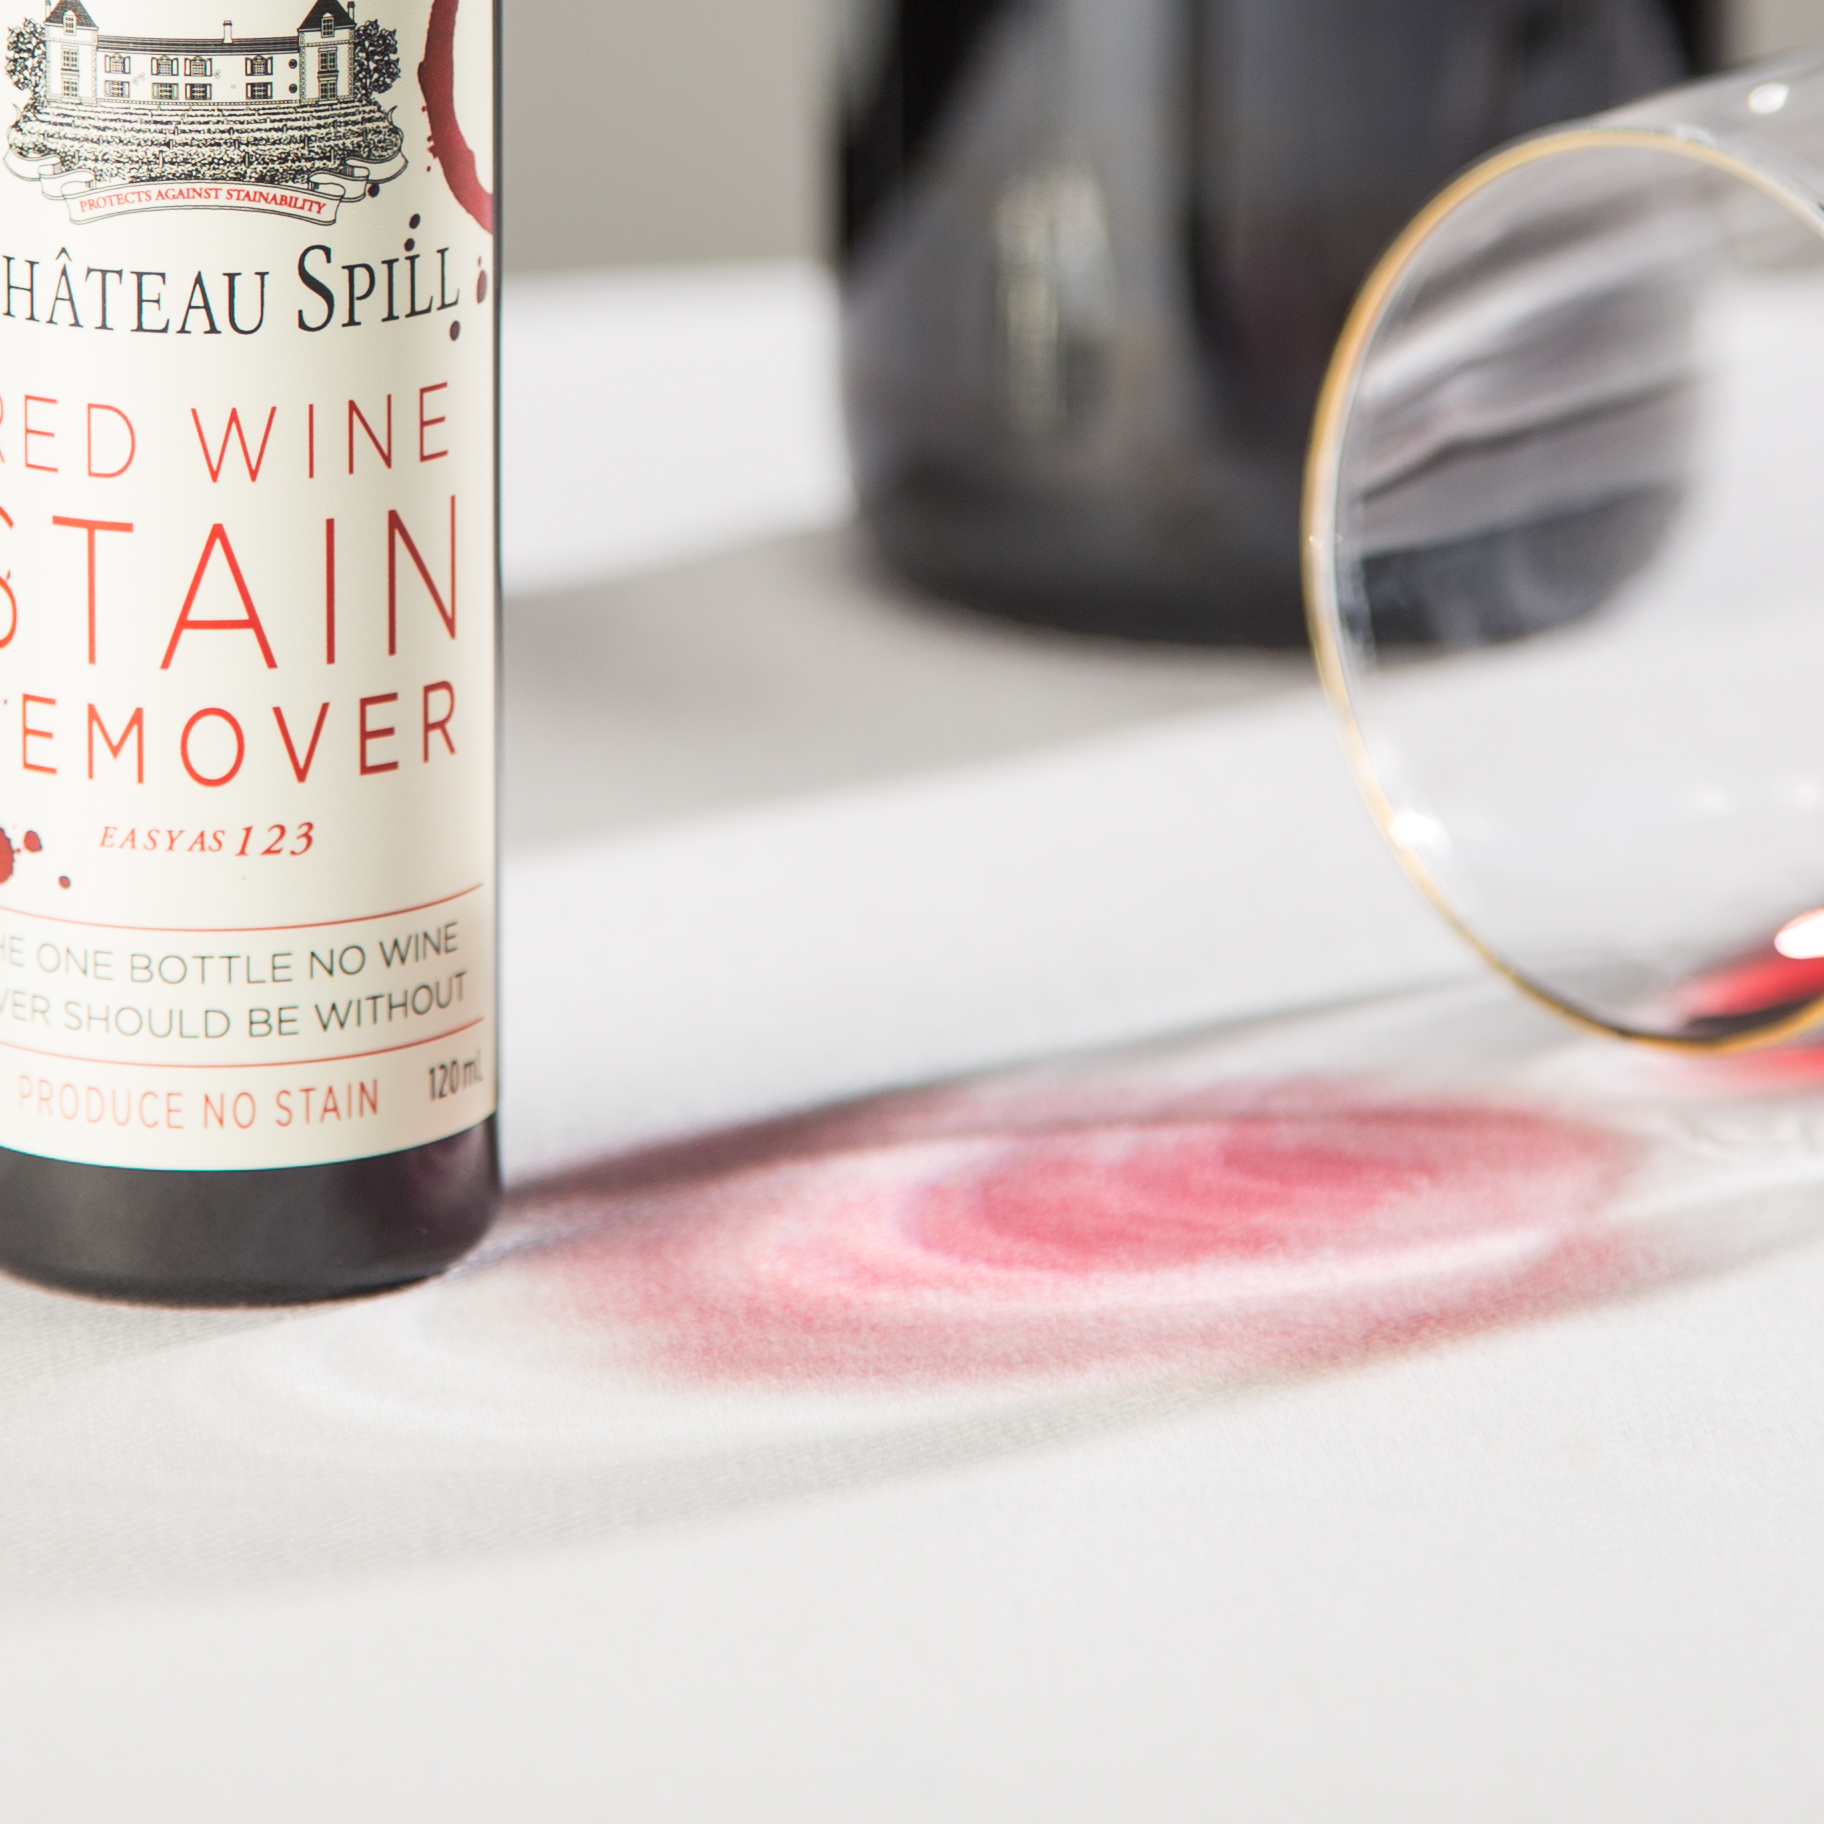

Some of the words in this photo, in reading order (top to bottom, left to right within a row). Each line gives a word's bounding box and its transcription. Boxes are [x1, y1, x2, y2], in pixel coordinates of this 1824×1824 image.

[79, 190, 152, 213] PROTECTS
[155, 186, 222, 202] AGAINST
[225, 188, 327, 215] STAINABILITY
[297, 243, 461, 332] SPILL
[190, 381, 449, 484] WINE
[36, 943, 114, 981] ONE
[130, 952, 294, 985] BOTTLE
[308, 945, 366, 980] NO
[379, 921, 460, 968] WINE
[63, 1001, 231, 1039] SHOULD
[248, 1006, 300, 1038] BE
[314, 972, 468, 1032] WITHOUT
[18, 1075, 185, 1130] PRODUCE
[203, 1091, 257, 1129] NO
[275, 1079, 379, 1127] STAIN
